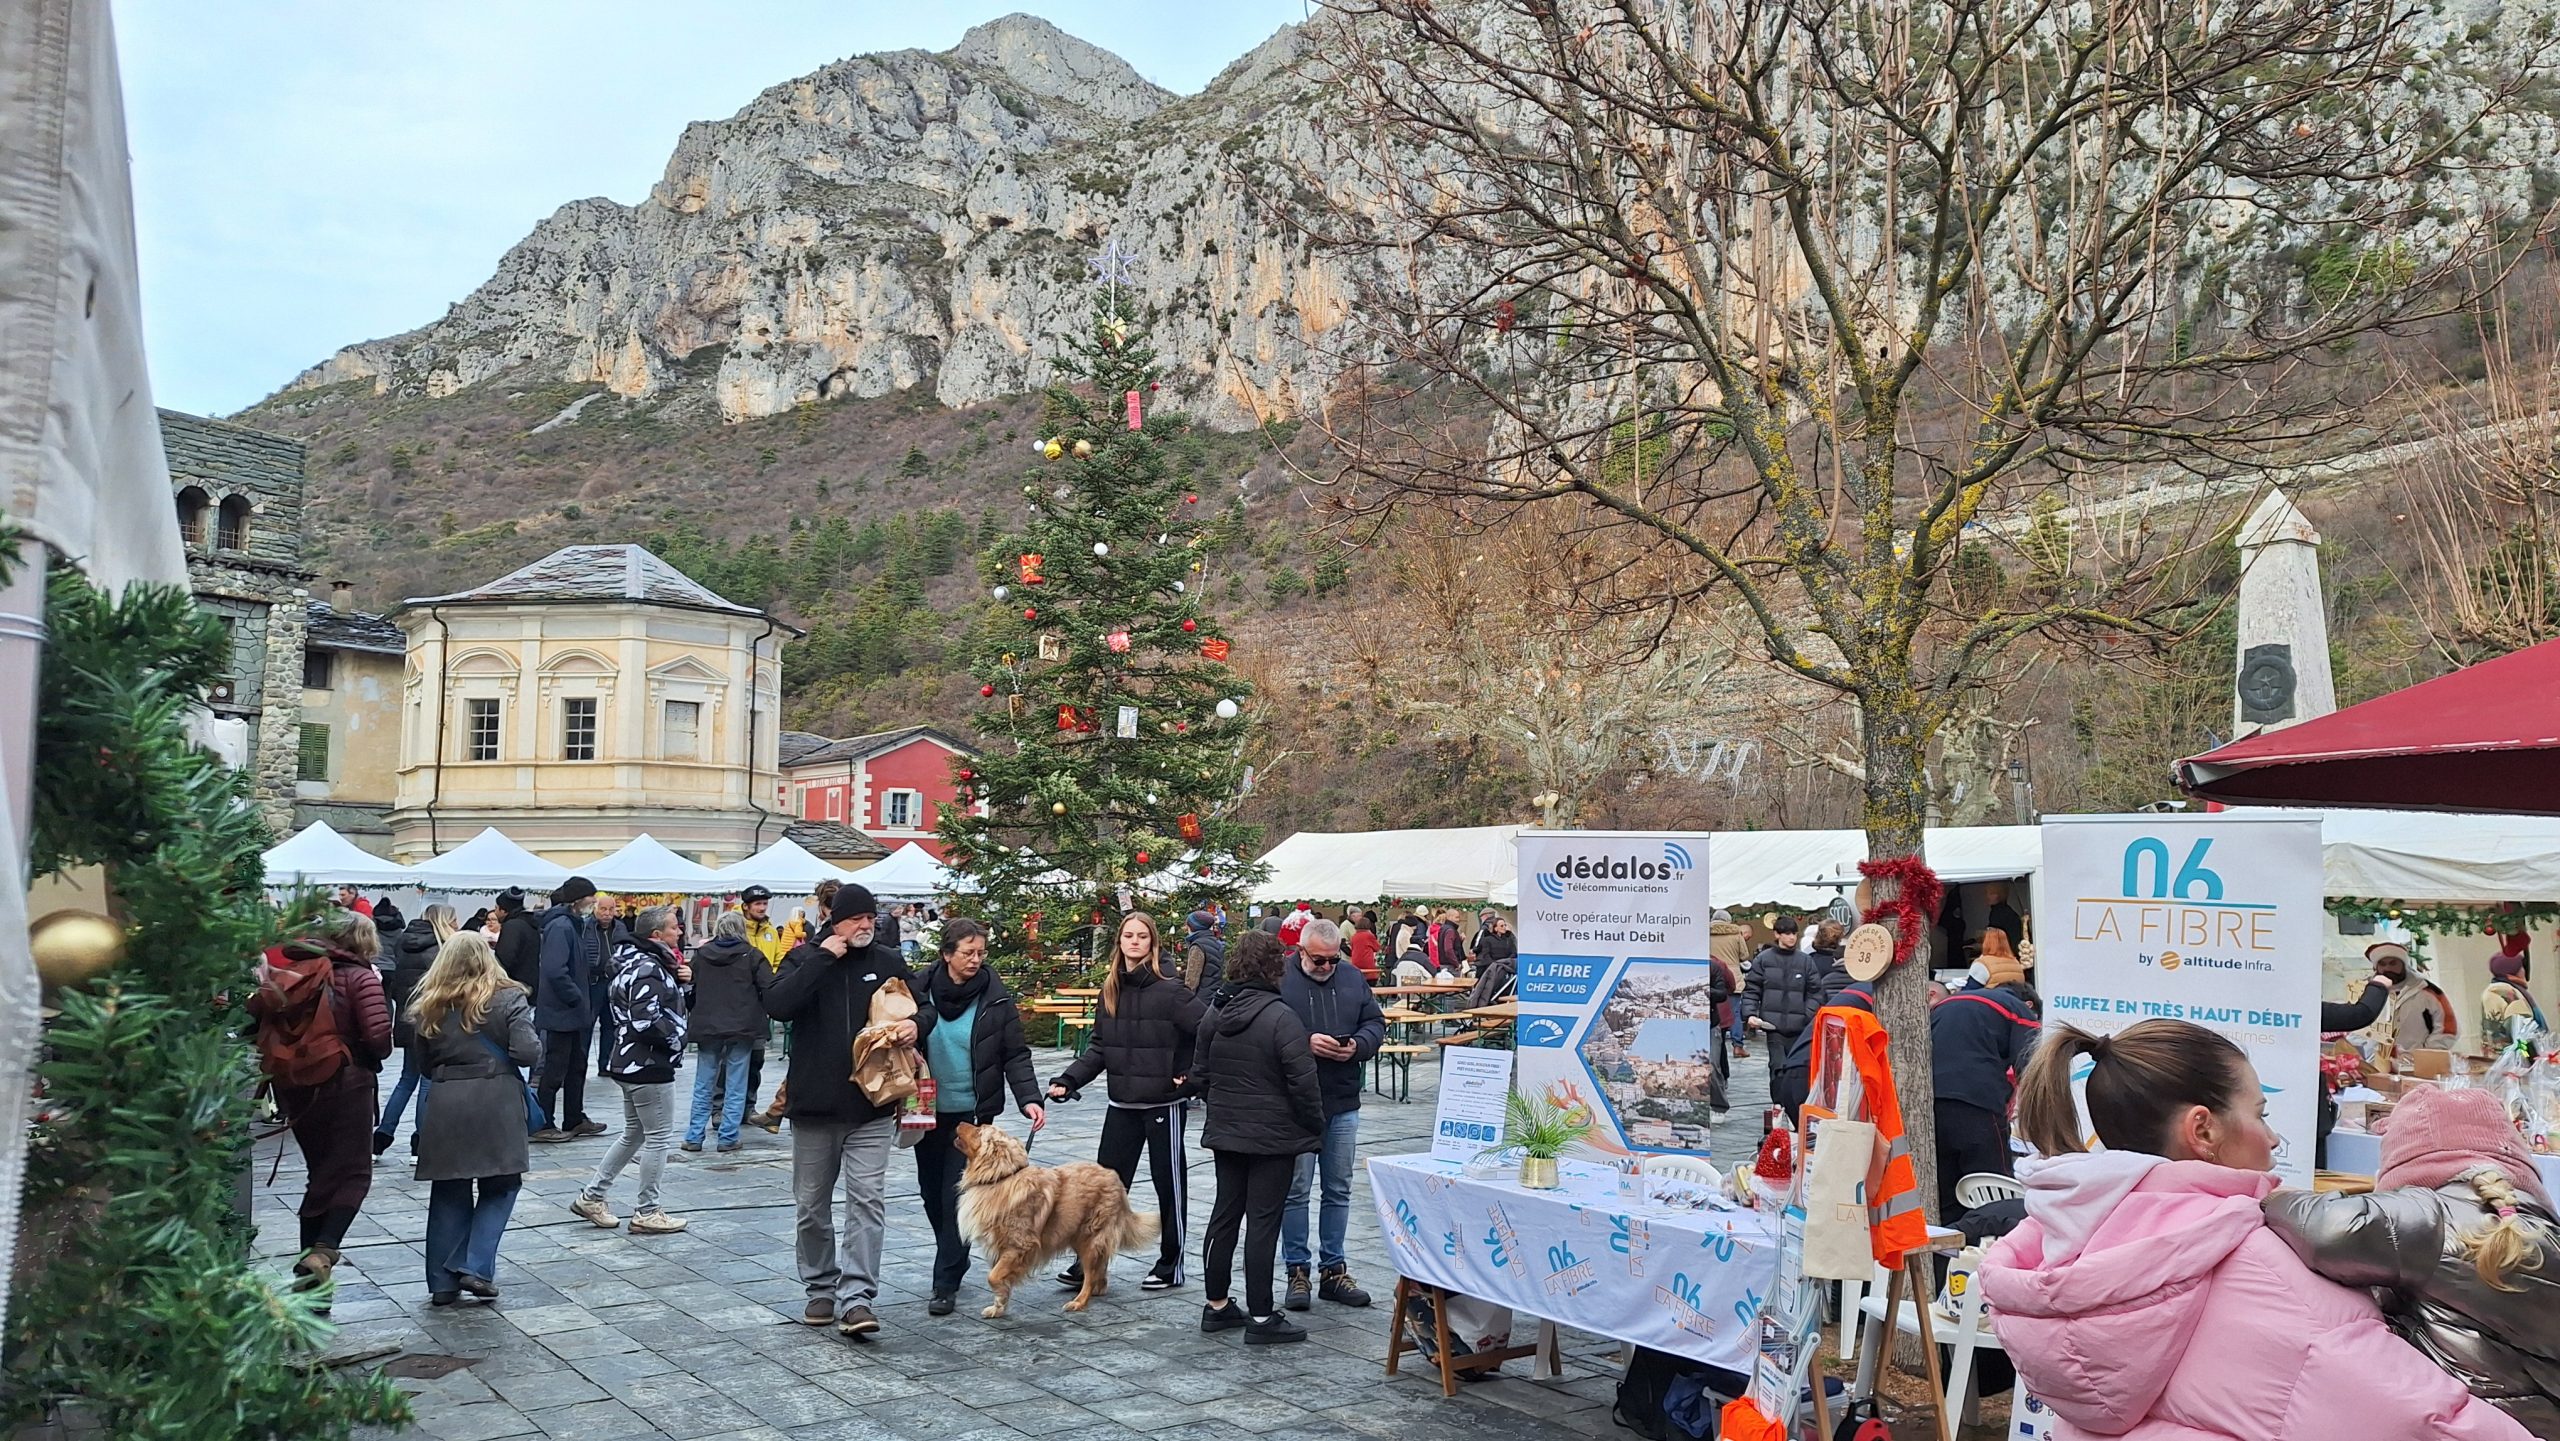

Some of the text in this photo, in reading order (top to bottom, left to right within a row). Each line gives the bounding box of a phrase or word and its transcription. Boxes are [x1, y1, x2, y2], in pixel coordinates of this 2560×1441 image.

[2122, 836, 2224, 901] 06
[1567, 882, 1669, 893] Télécommunications
[1536, 910, 1692, 927] Votre opérateur Maralpin
[2074, 905, 2277, 951] LA FIBRE
[1560, 928, 1665, 943] Très Haut Débit
[1857, 951, 1872, 964] 38
[2138, 952, 2154, 966] by
[2183, 956, 2243, 970] altitude
[1527, 963, 1592, 978] LA FIBRE
[1526, 982, 1587, 994] CHEZ VOUS
[2053, 995, 2303, 1029] SURFEZ EN TRÈS HAUT DÉBIT
[1548, 1239, 1577, 1273] 06
[1560, 1260, 1596, 1289] FIBRE
[1673, 1272, 1702, 1311] 06
[1673, 1300, 1716, 1335] FIBRE
